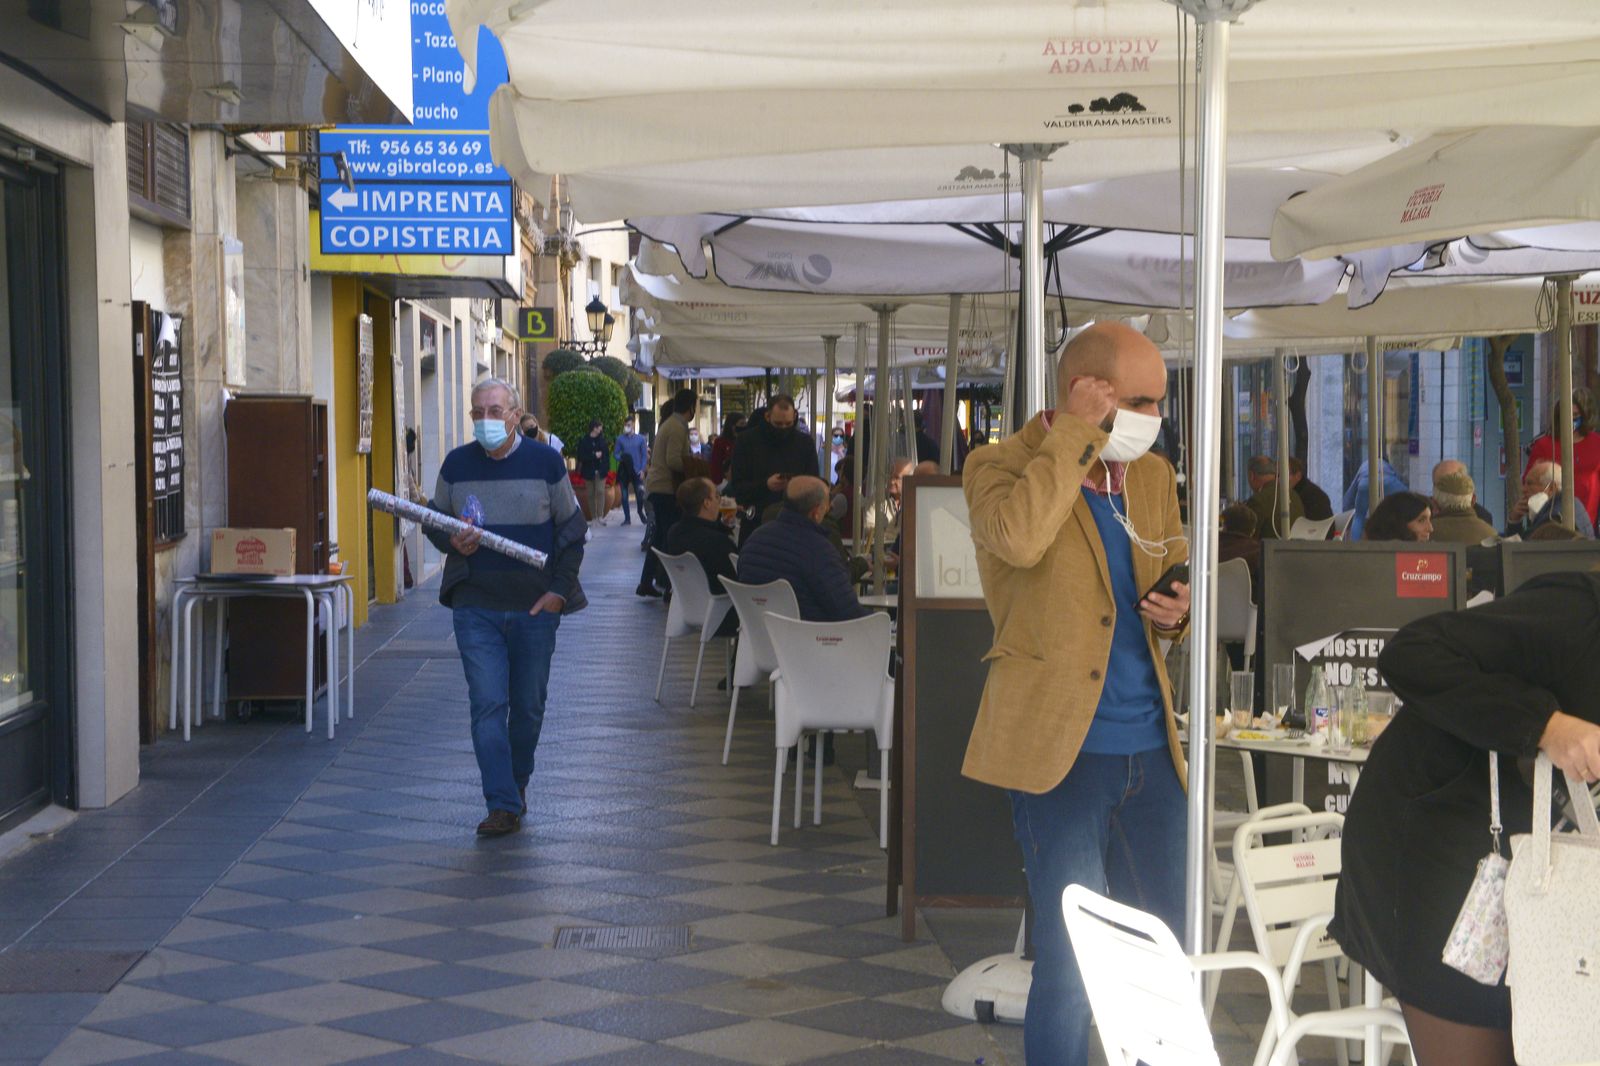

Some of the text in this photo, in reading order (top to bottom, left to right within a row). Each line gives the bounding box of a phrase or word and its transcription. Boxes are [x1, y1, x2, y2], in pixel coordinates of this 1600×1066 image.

[412, 102, 459, 119] aucho
[1043, 116, 1172, 128] VALDERRAMA MASTERS
[347, 140, 482, 156] Tlf: 956 65 36 69
[346, 158, 493, 177] ww.gibralcop.es
[362, 190, 504, 213] IMPRENTA
[329, 226, 503, 248] COPISTERIA
[527, 310, 547, 335] B
[1402, 571, 1442, 583] Cruzcampo
[1325, 661, 1353, 686] NO
[1324, 794, 1353, 814] CU
